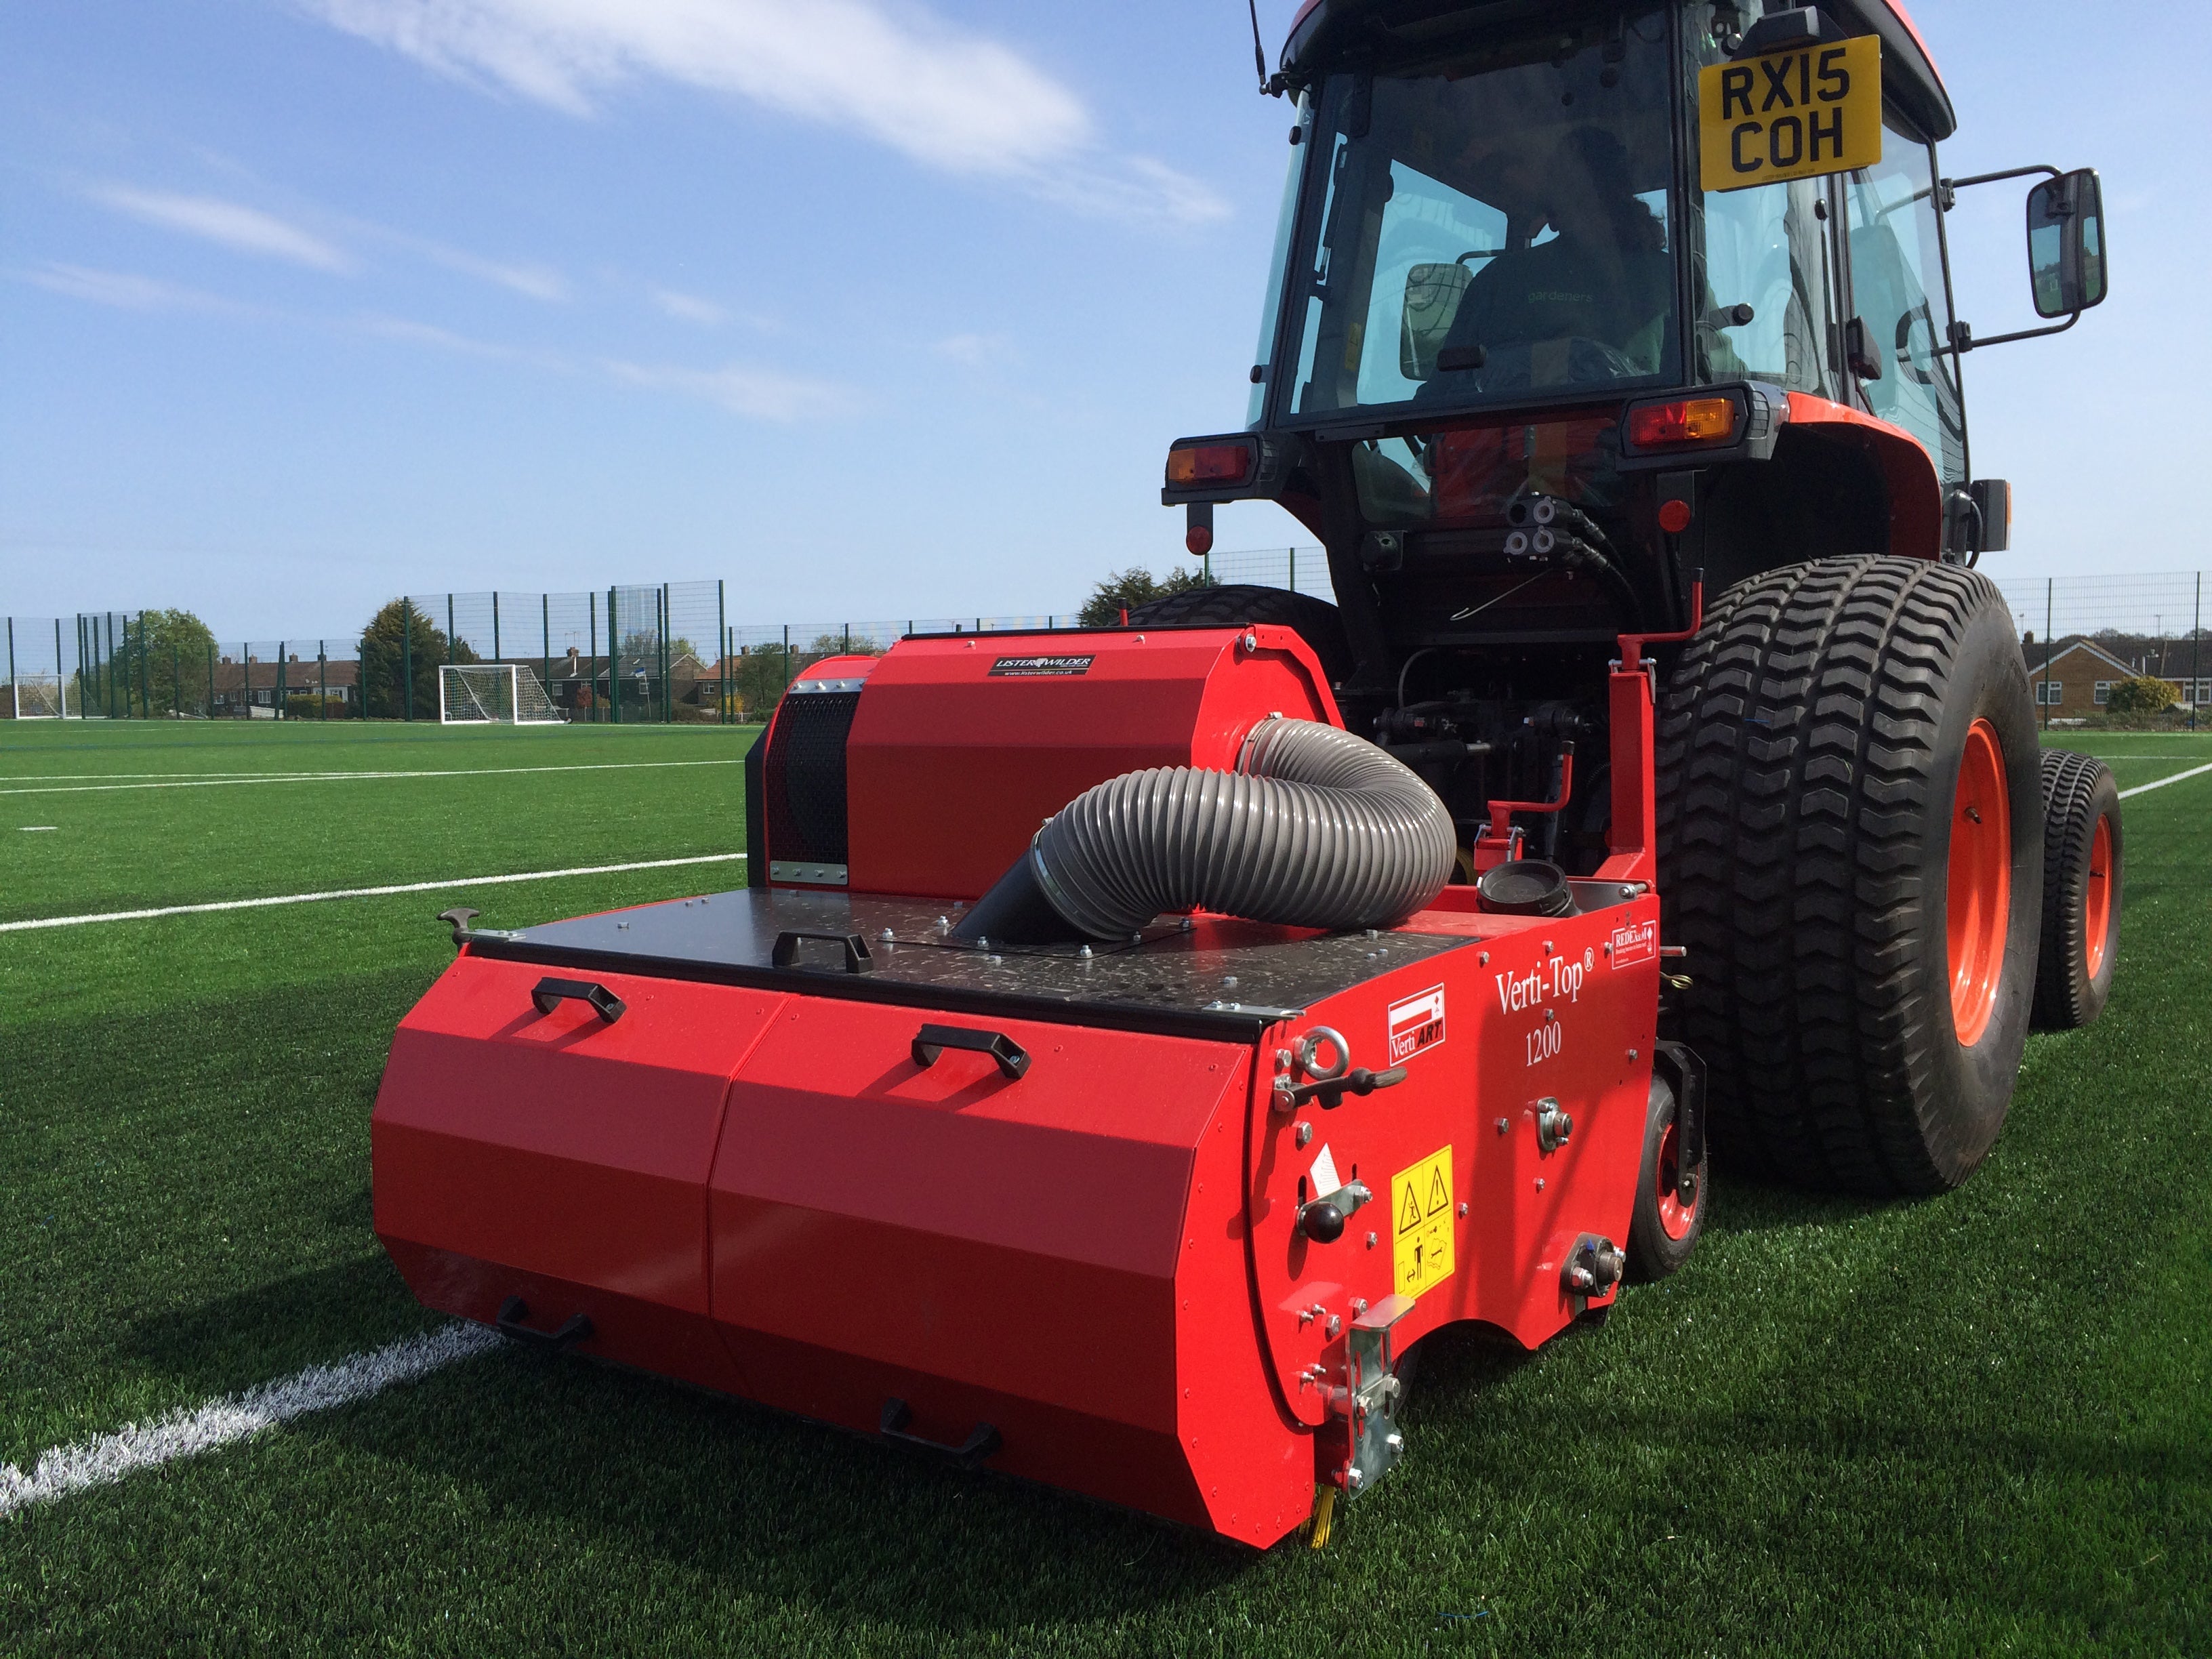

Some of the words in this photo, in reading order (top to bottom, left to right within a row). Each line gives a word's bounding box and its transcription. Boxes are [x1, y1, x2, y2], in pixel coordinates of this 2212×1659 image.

[1722, 47, 1850, 120] RX15
[1732, 106, 1843, 173] COH
[1528, 291, 1593, 303] gardeners
[1391, 1030, 1415, 1058] Verti
[1417, 1019, 1441, 1047] ART
[1525, 1021, 1561, 1067] 1200
